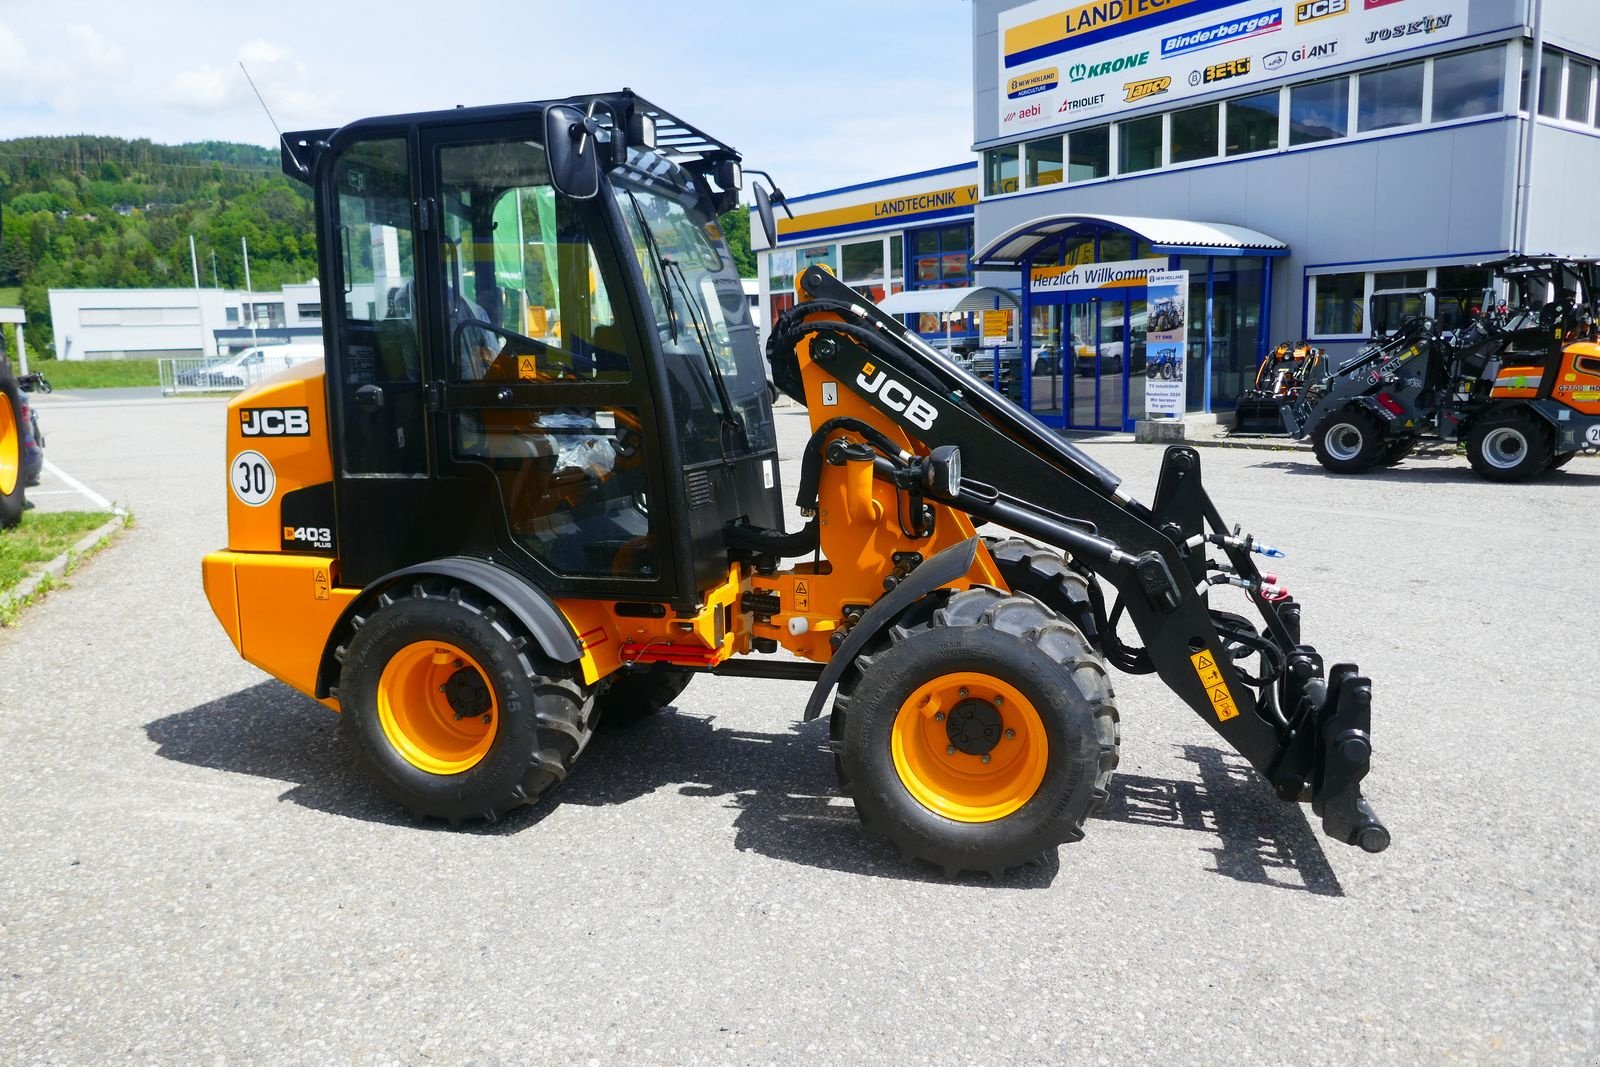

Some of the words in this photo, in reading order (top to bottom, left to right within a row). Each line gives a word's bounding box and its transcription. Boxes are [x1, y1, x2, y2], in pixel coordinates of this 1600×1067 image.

[1298, 0, 1346, 21] JCB
[1164, 12, 1278, 51] Binderberger
[1365, 14, 1452, 44] JOSKIN
[1087, 51, 1149, 78] KRONE
[1018, 79, 1030, 87] NEW
[1031, 73, 1055, 84] HOLLAND
[1018, 86, 1046, 97] AGRICULTURE
[1068, 94, 1105, 110] TRIOLIET
[1019, 104, 1040, 118] aebi
[874, 191, 955, 217] LANDTECHNIK
[1033, 270, 1079, 287] Herzlich
[856, 371, 938, 431] JCB
[242, 410, 309, 435] JCB
[1592, 429, 1600, 441] 2
[239, 462, 265, 494] 30
[294, 527, 331, 542] 403
